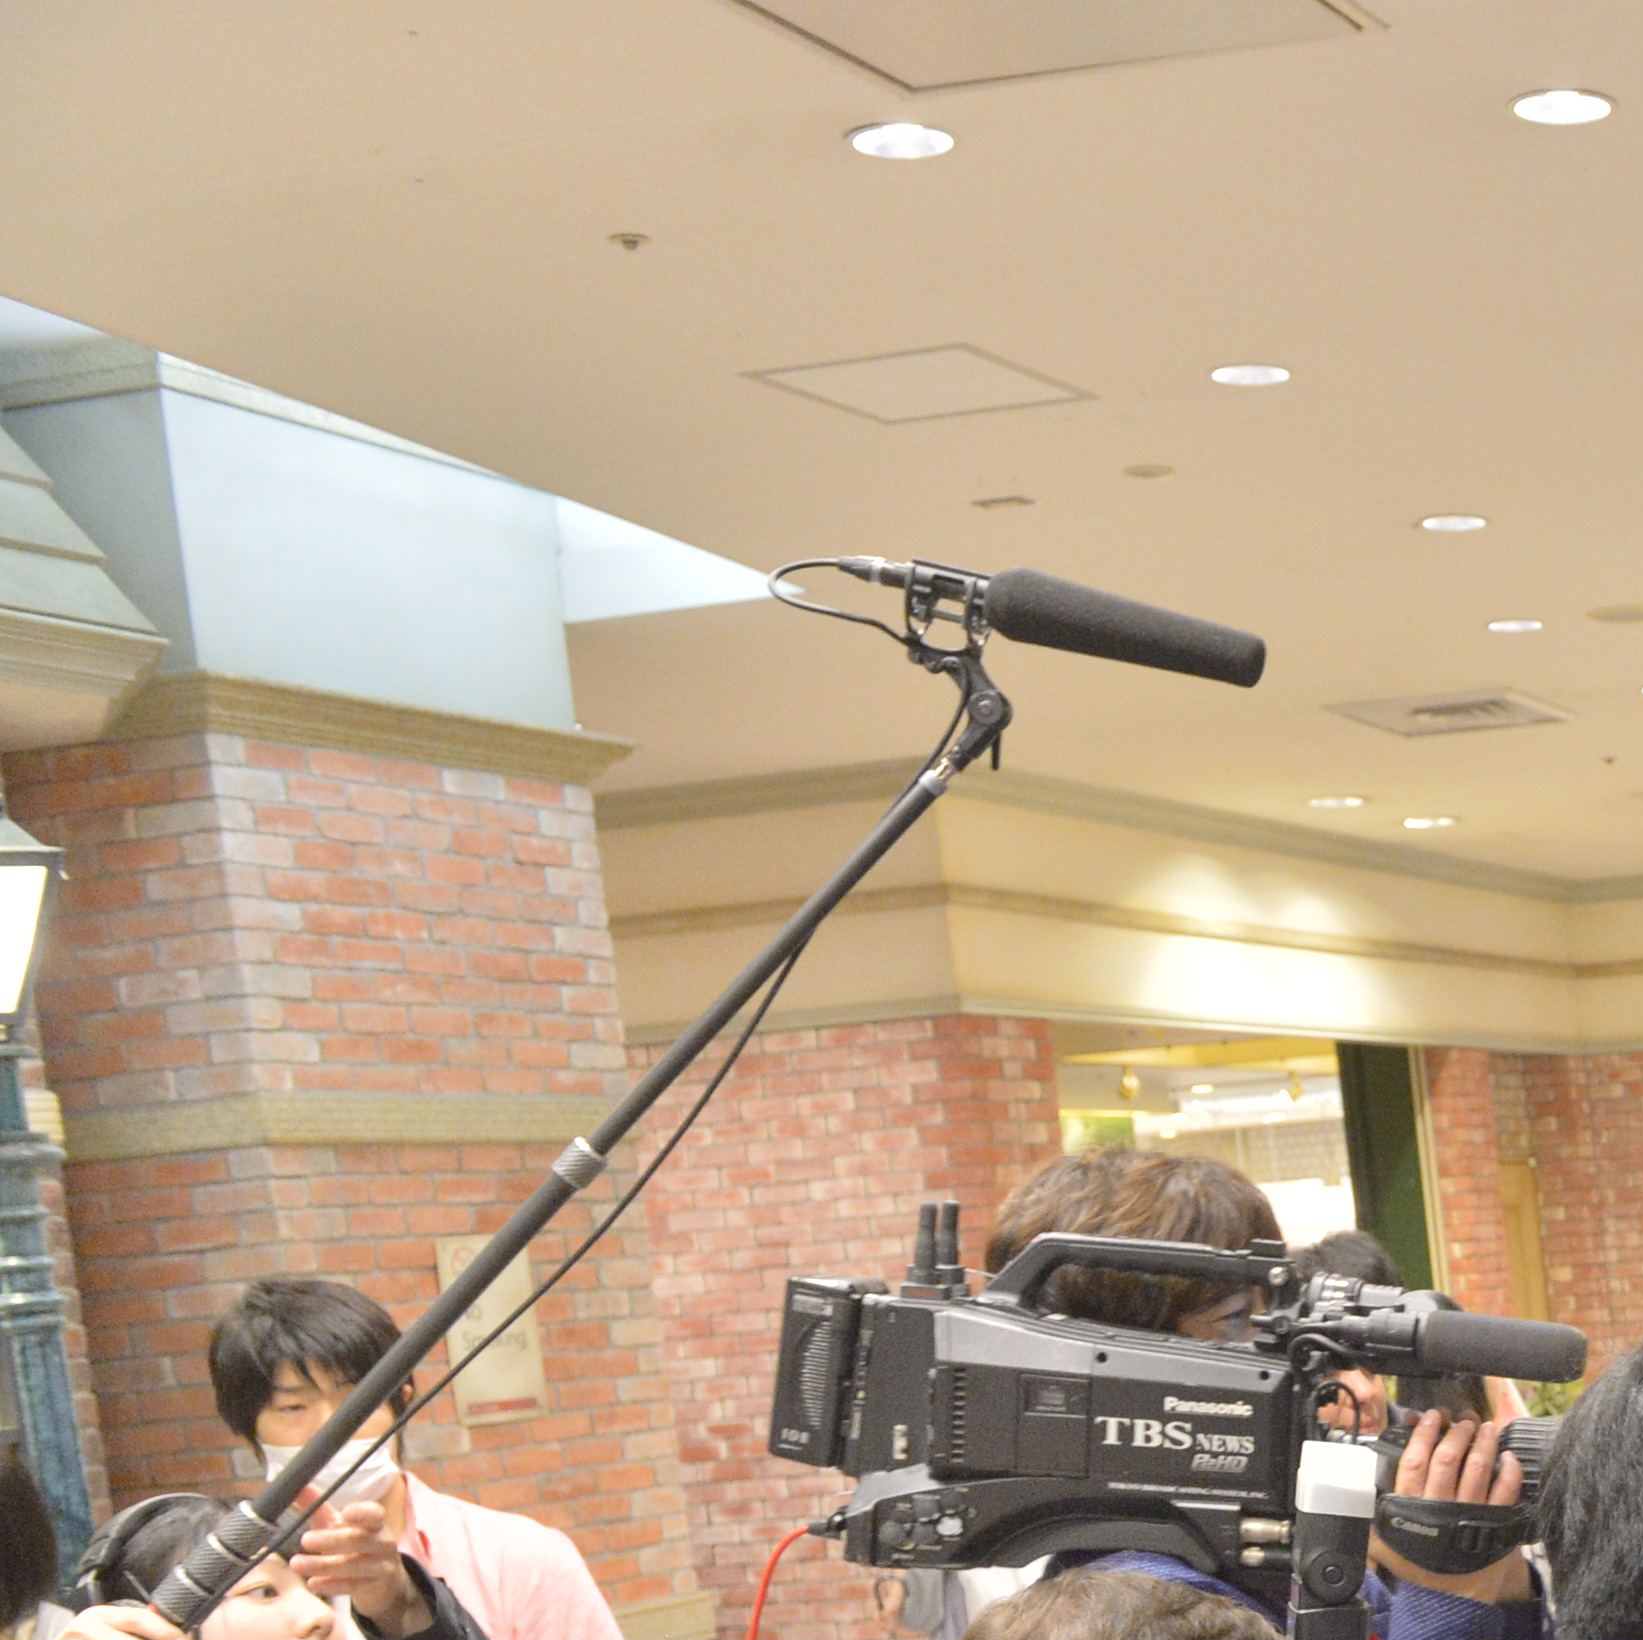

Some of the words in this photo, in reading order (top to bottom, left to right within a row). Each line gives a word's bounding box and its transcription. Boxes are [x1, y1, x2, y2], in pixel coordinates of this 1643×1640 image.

[1163, 1396, 1254, 1418] Panasonic
[1094, 1416, 1194, 1450] TBS
[1195, 1433, 1255, 1455] NEWS
